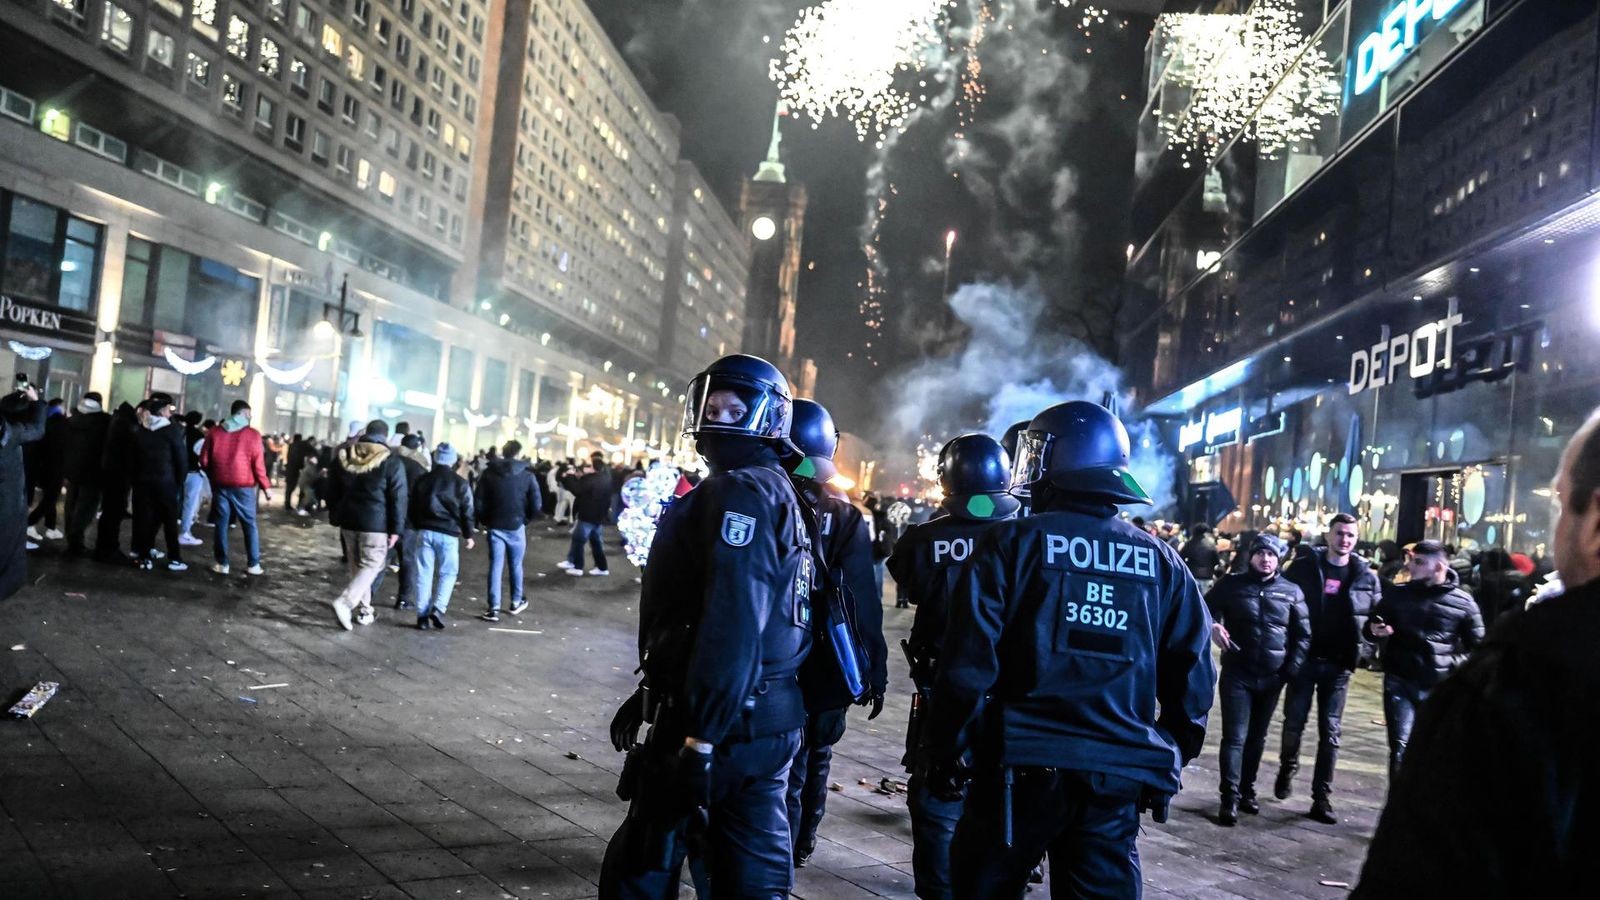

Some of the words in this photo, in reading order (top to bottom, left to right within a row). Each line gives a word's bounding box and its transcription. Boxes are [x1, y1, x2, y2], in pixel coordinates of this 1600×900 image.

[0, 296, 61, 330] POPKEN
[1348, 311, 1463, 395] DEPOT
[1046, 534, 1156, 577] POLIZEI
[1086, 582, 1114, 605] BE
[1065, 602, 1128, 631] 36302
